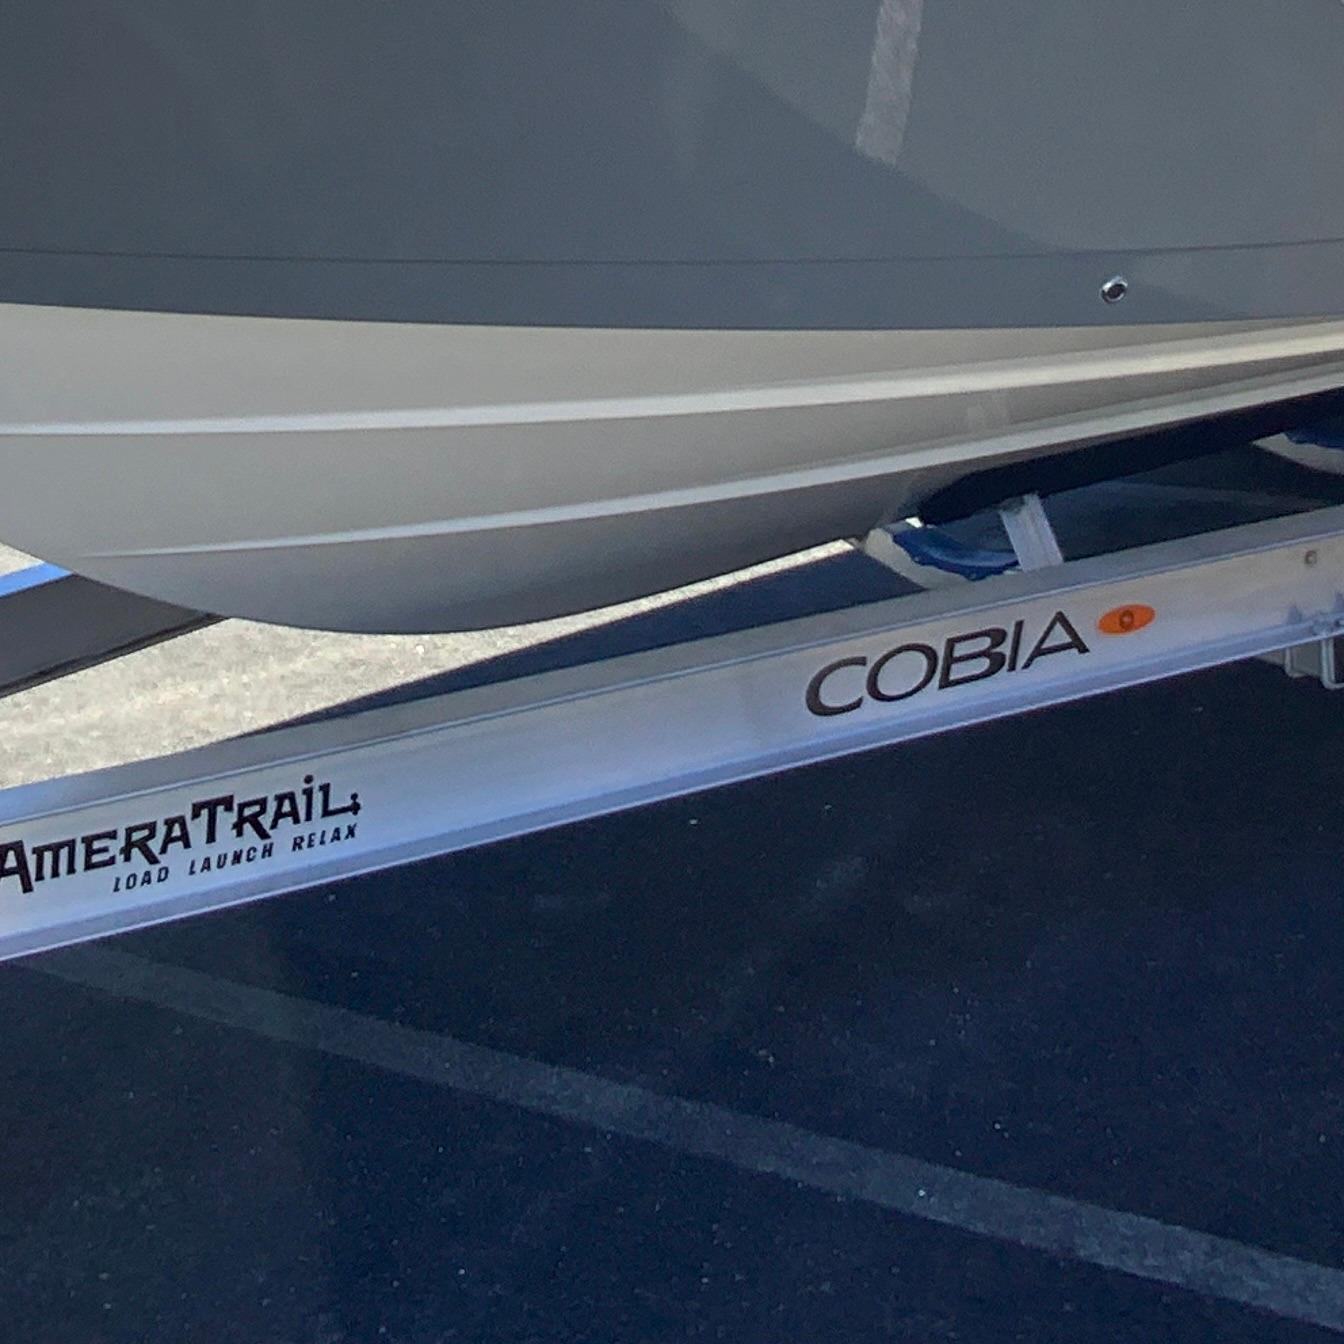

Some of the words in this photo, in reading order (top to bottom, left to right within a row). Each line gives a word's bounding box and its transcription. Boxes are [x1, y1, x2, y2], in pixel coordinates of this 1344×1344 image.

[805, 610, 1090, 717] COBIA
[112, 865, 170, 894] LOAD
[188, 842, 275, 877] LAUNCH
[291, 822, 358, 853] RELAX
